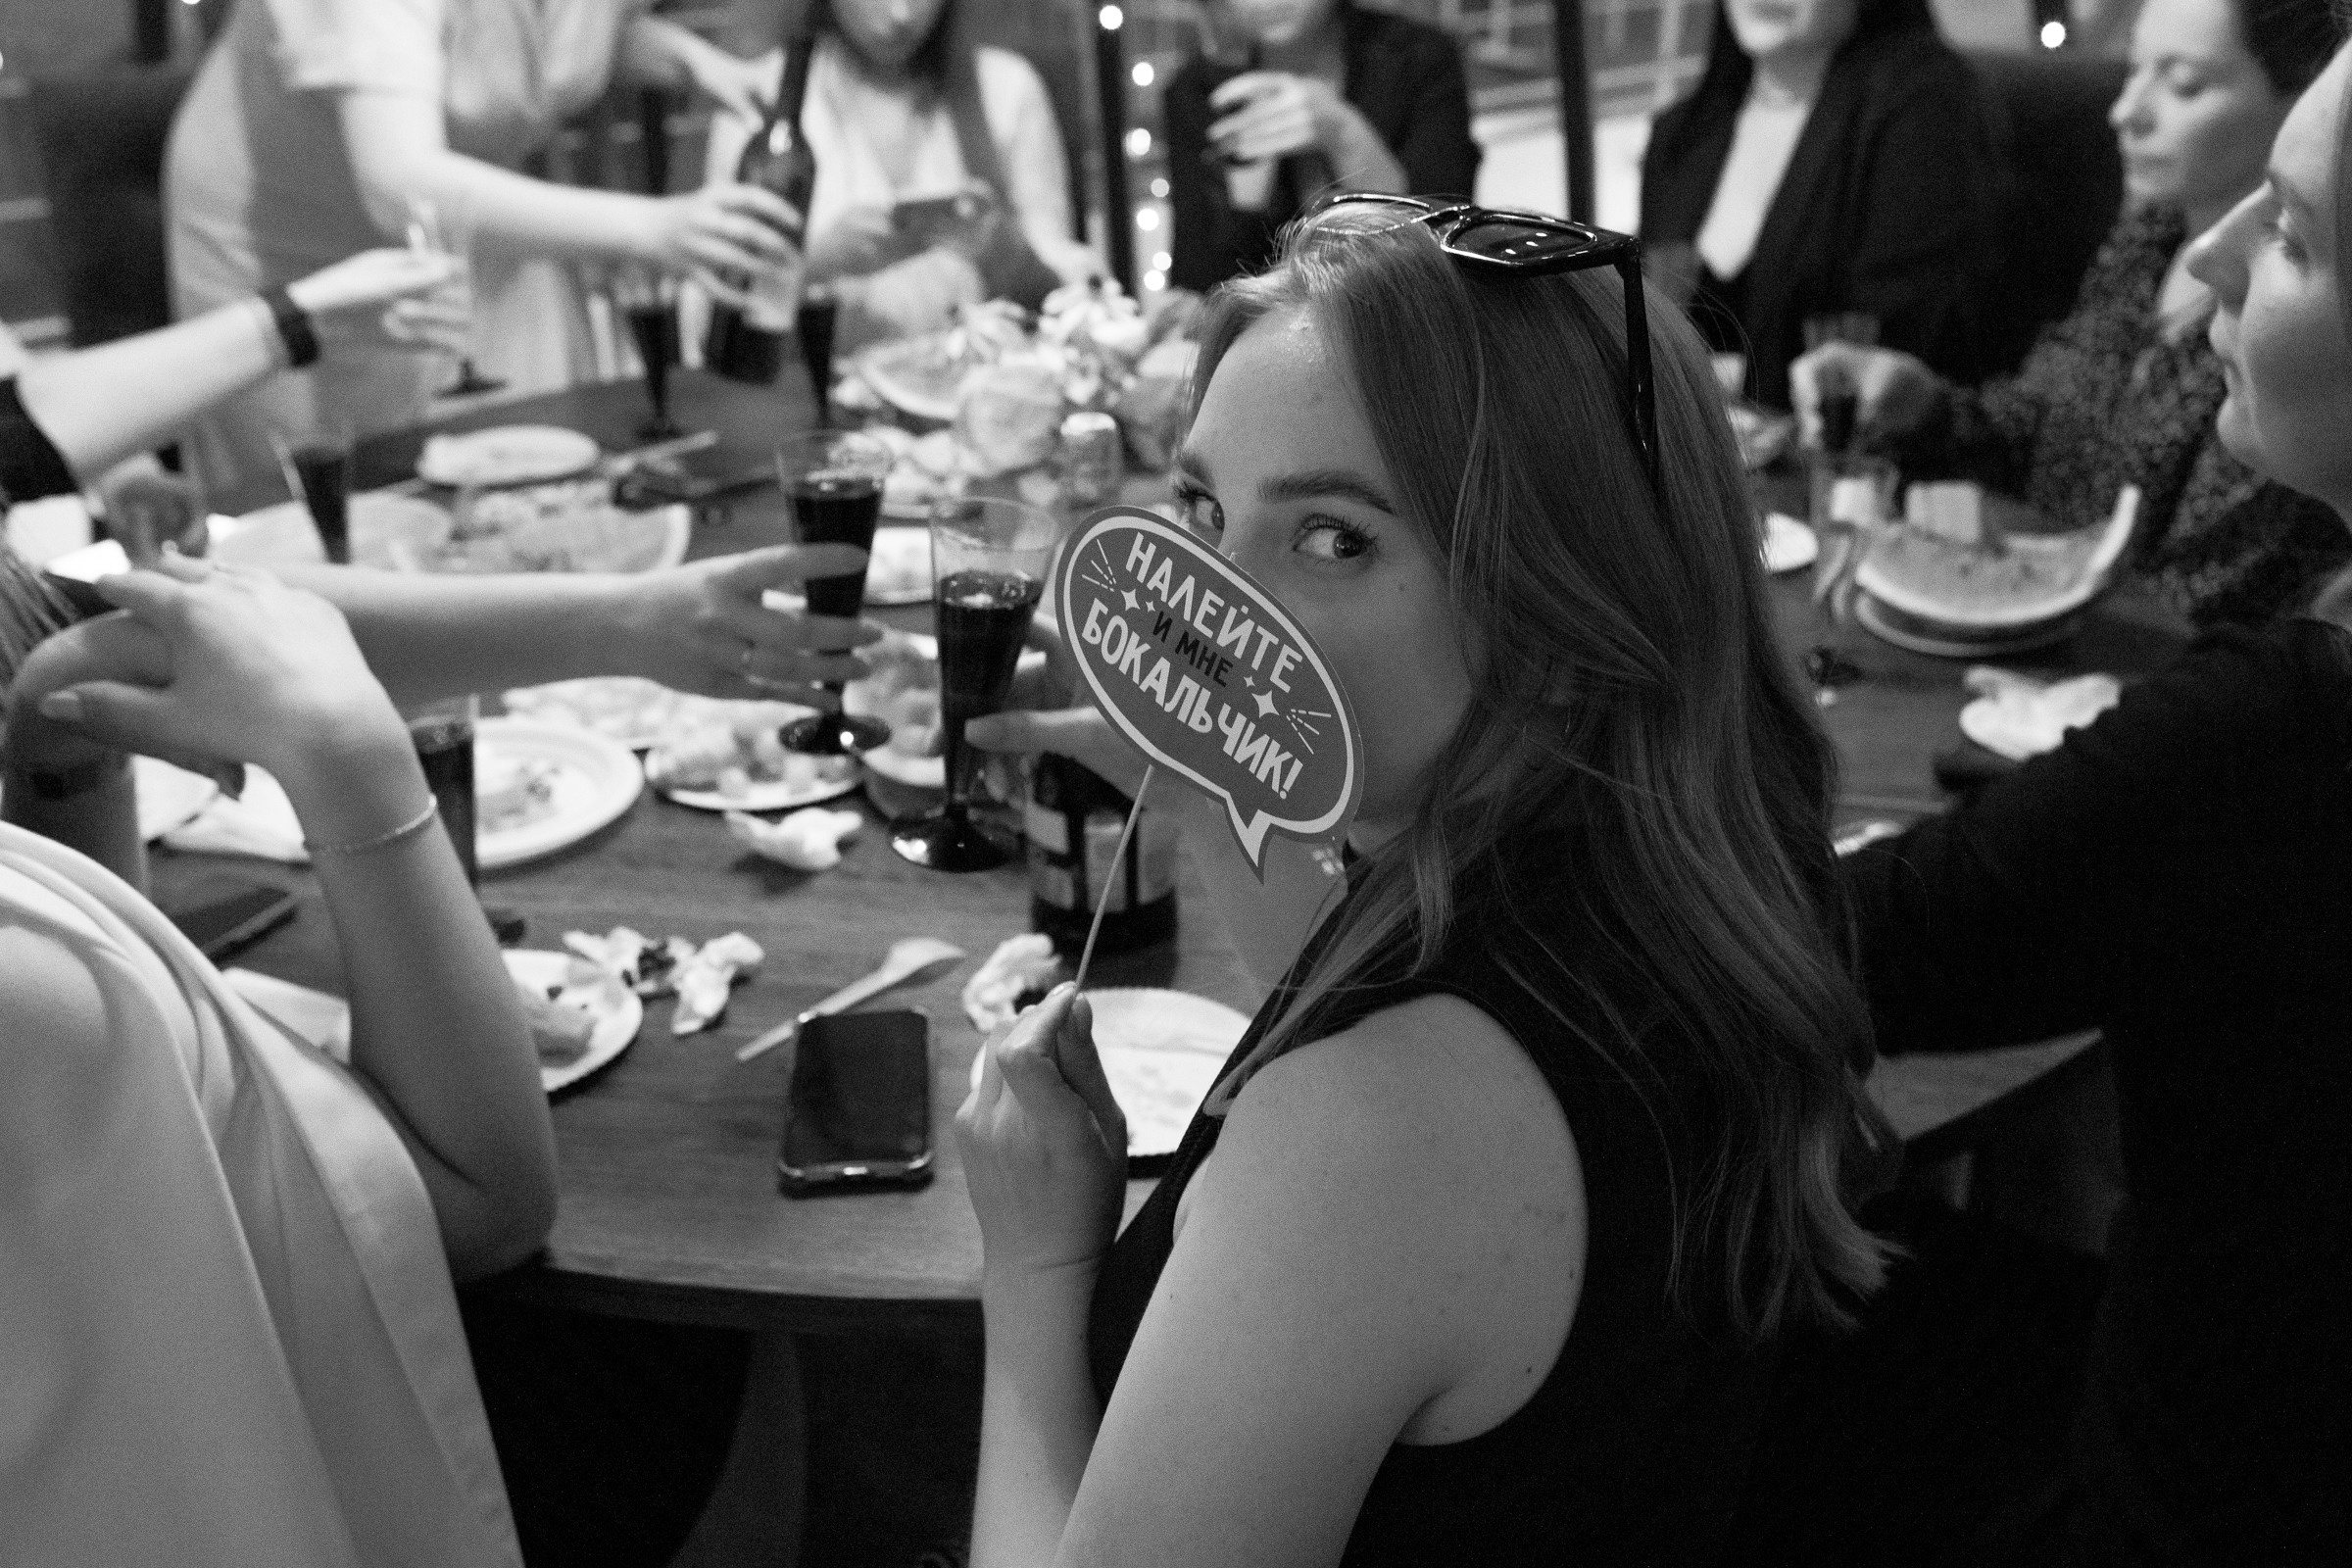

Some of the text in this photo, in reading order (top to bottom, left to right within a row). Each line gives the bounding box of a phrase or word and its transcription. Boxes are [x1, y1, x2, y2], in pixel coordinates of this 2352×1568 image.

[1125, 531, 1303, 693] НАЛЕЙТЕ
[1152, 611, 1234, 687] И МНЕ
[1082, 598, 1303, 800] БОКАЛЬЧИК!
